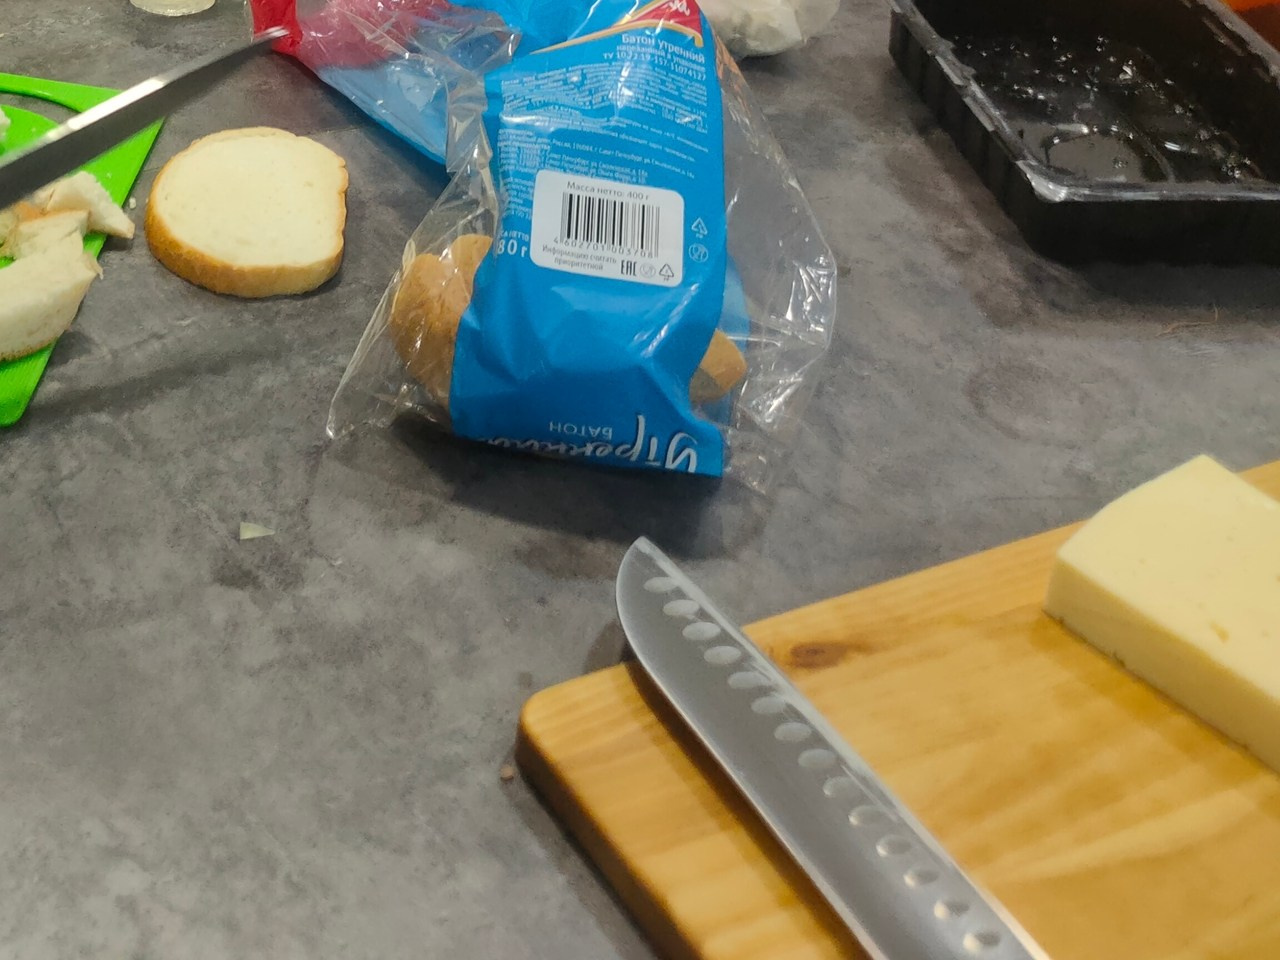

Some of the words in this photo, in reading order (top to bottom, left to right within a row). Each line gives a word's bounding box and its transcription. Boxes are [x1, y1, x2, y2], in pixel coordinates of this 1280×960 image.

[621, 33, 655, 46] Батон
[658, 39, 705, 63] утренний
[567, 181, 595, 193] Масса
[597, 187, 623, 198] нетто:
[626, 191, 644, 201] 400
[497, 239, 518, 255] 80
[542, 244, 588, 260] Информацию
[549, 420, 613, 439] БАТОН
